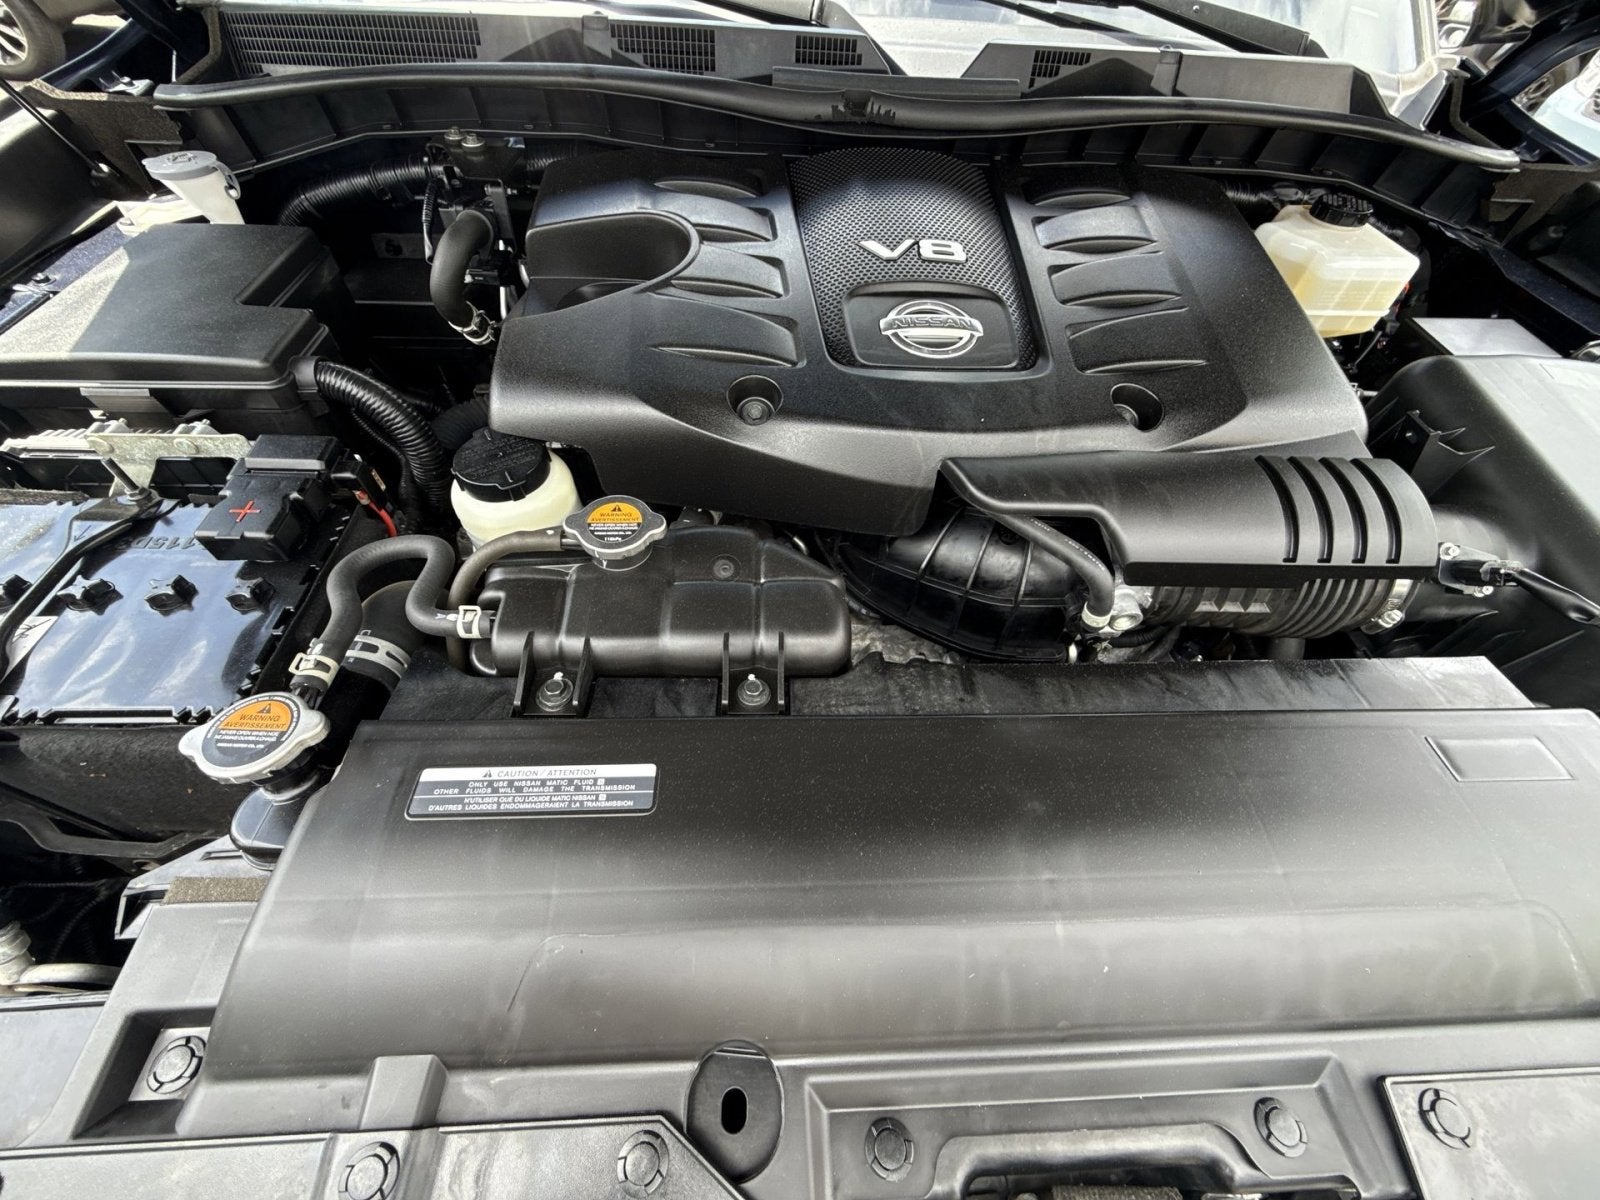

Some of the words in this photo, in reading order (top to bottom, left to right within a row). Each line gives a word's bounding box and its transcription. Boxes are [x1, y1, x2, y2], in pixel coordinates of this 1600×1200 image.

[858, 238, 967, 263] V8
[892, 316, 973, 329] NISSAN
[239, 713, 280, 721] WARNING
[497, 770, 539, 778] CAUTION
[547, 768, 597, 776] ATTENTION
[428, 803, 462, 812] D'AUTRES
[465, 803, 498, 811] LIQUIDES
